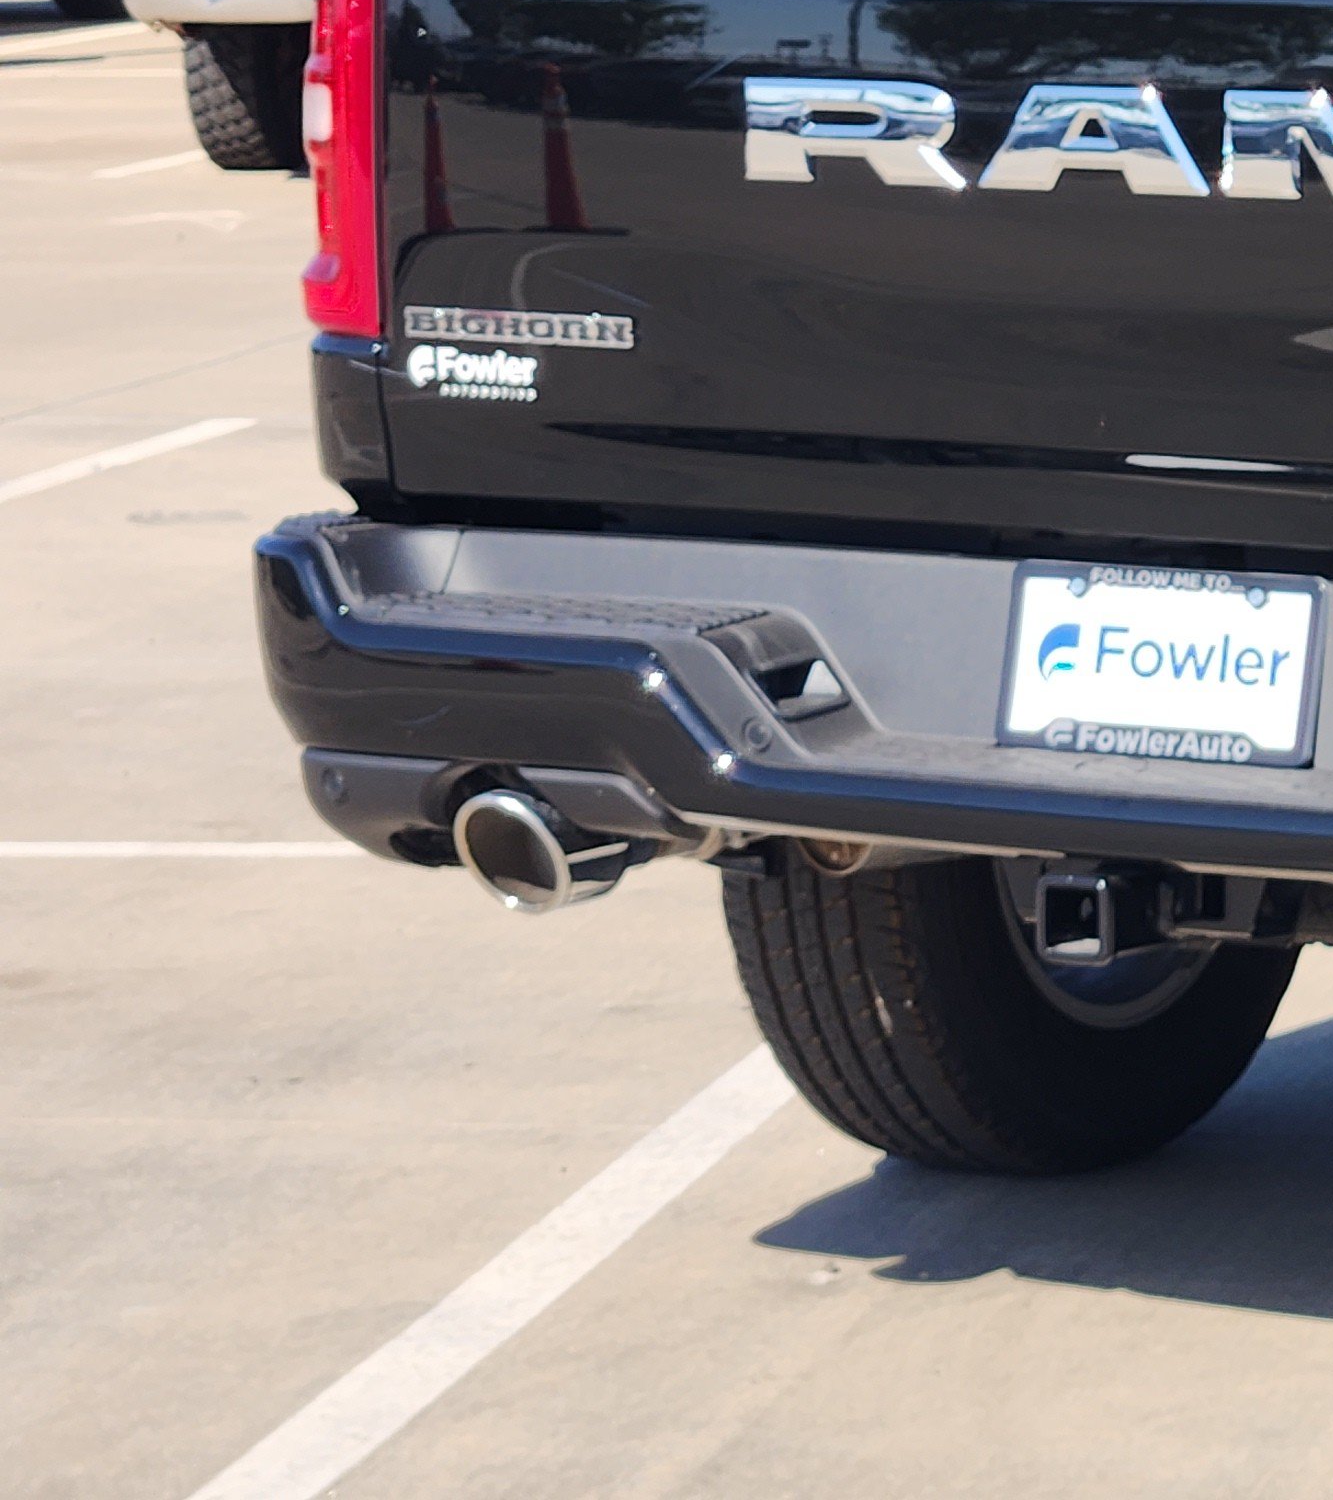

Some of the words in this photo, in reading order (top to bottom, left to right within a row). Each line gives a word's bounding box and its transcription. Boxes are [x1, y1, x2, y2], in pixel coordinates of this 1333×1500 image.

[436, 345, 538, 387] Fowler
[1089, 566, 1170, 589] FOLLOW
[1172, 572, 1201, 591] ME
[1094, 625, 1291, 686] Fowler
[1075, 722, 1253, 763] FowlerAuto
